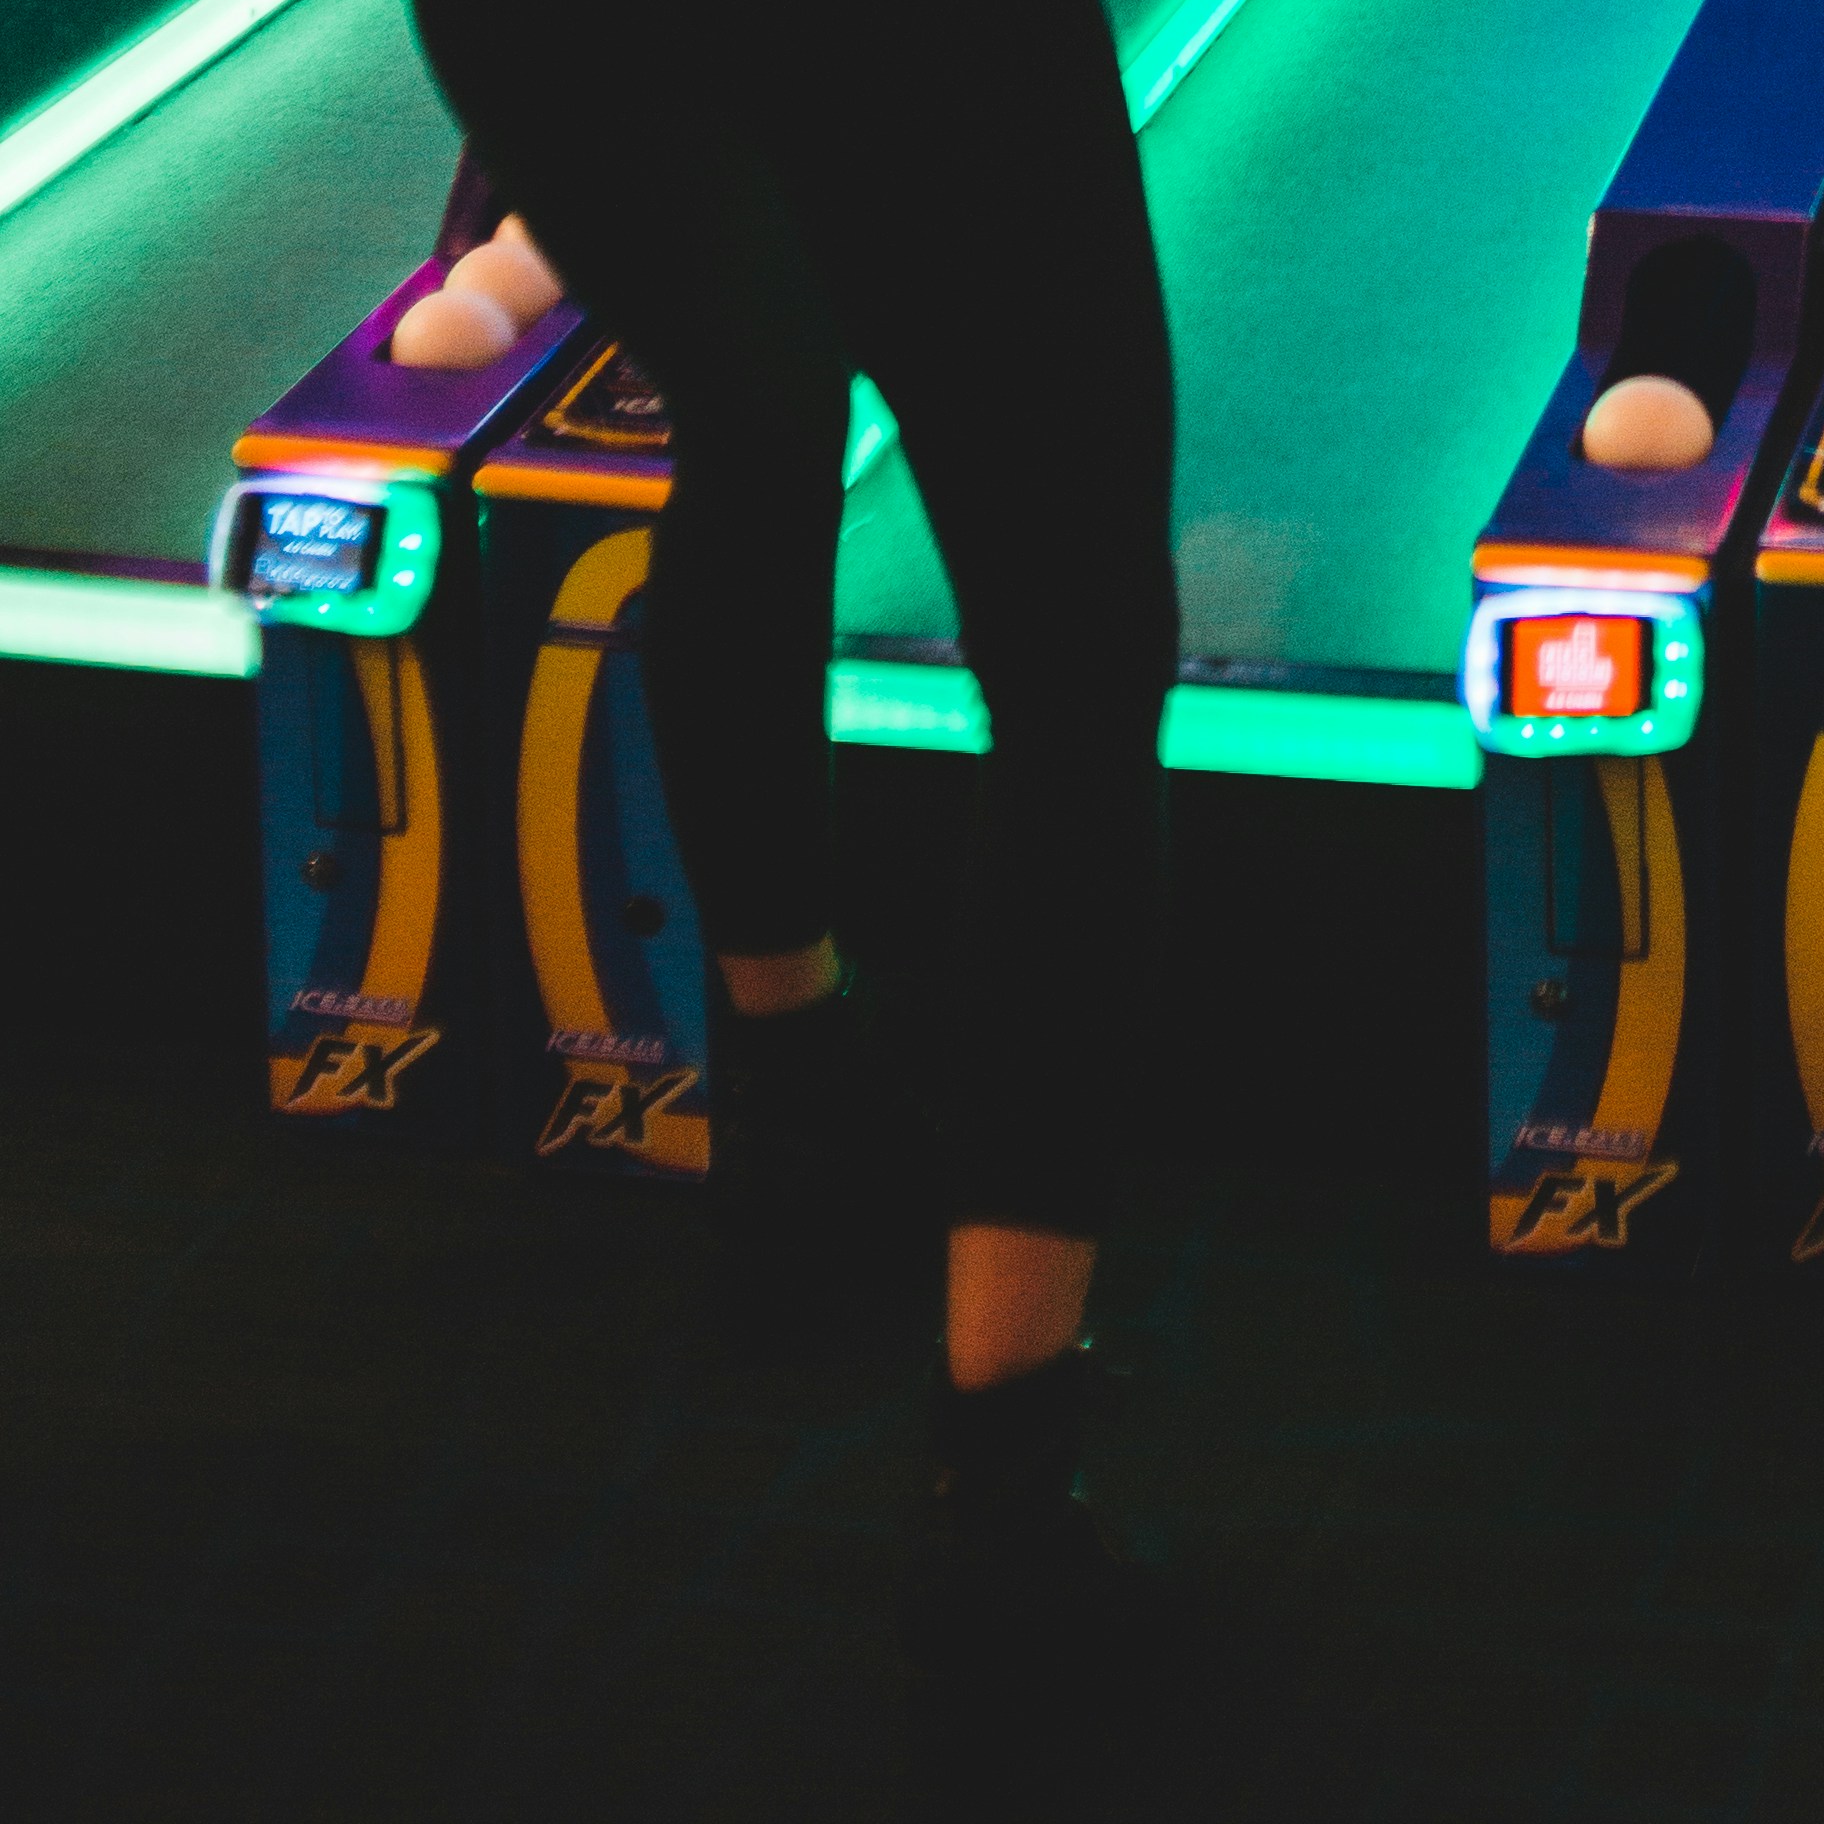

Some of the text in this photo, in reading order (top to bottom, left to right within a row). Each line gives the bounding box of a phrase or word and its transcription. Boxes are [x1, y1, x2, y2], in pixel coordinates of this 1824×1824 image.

[268, 501, 327, 537] TAP
[283, 1027, 440, 1109] FX
[537, 1067, 700, 1153] FX
[1500, 1160, 1680, 1252] FX
